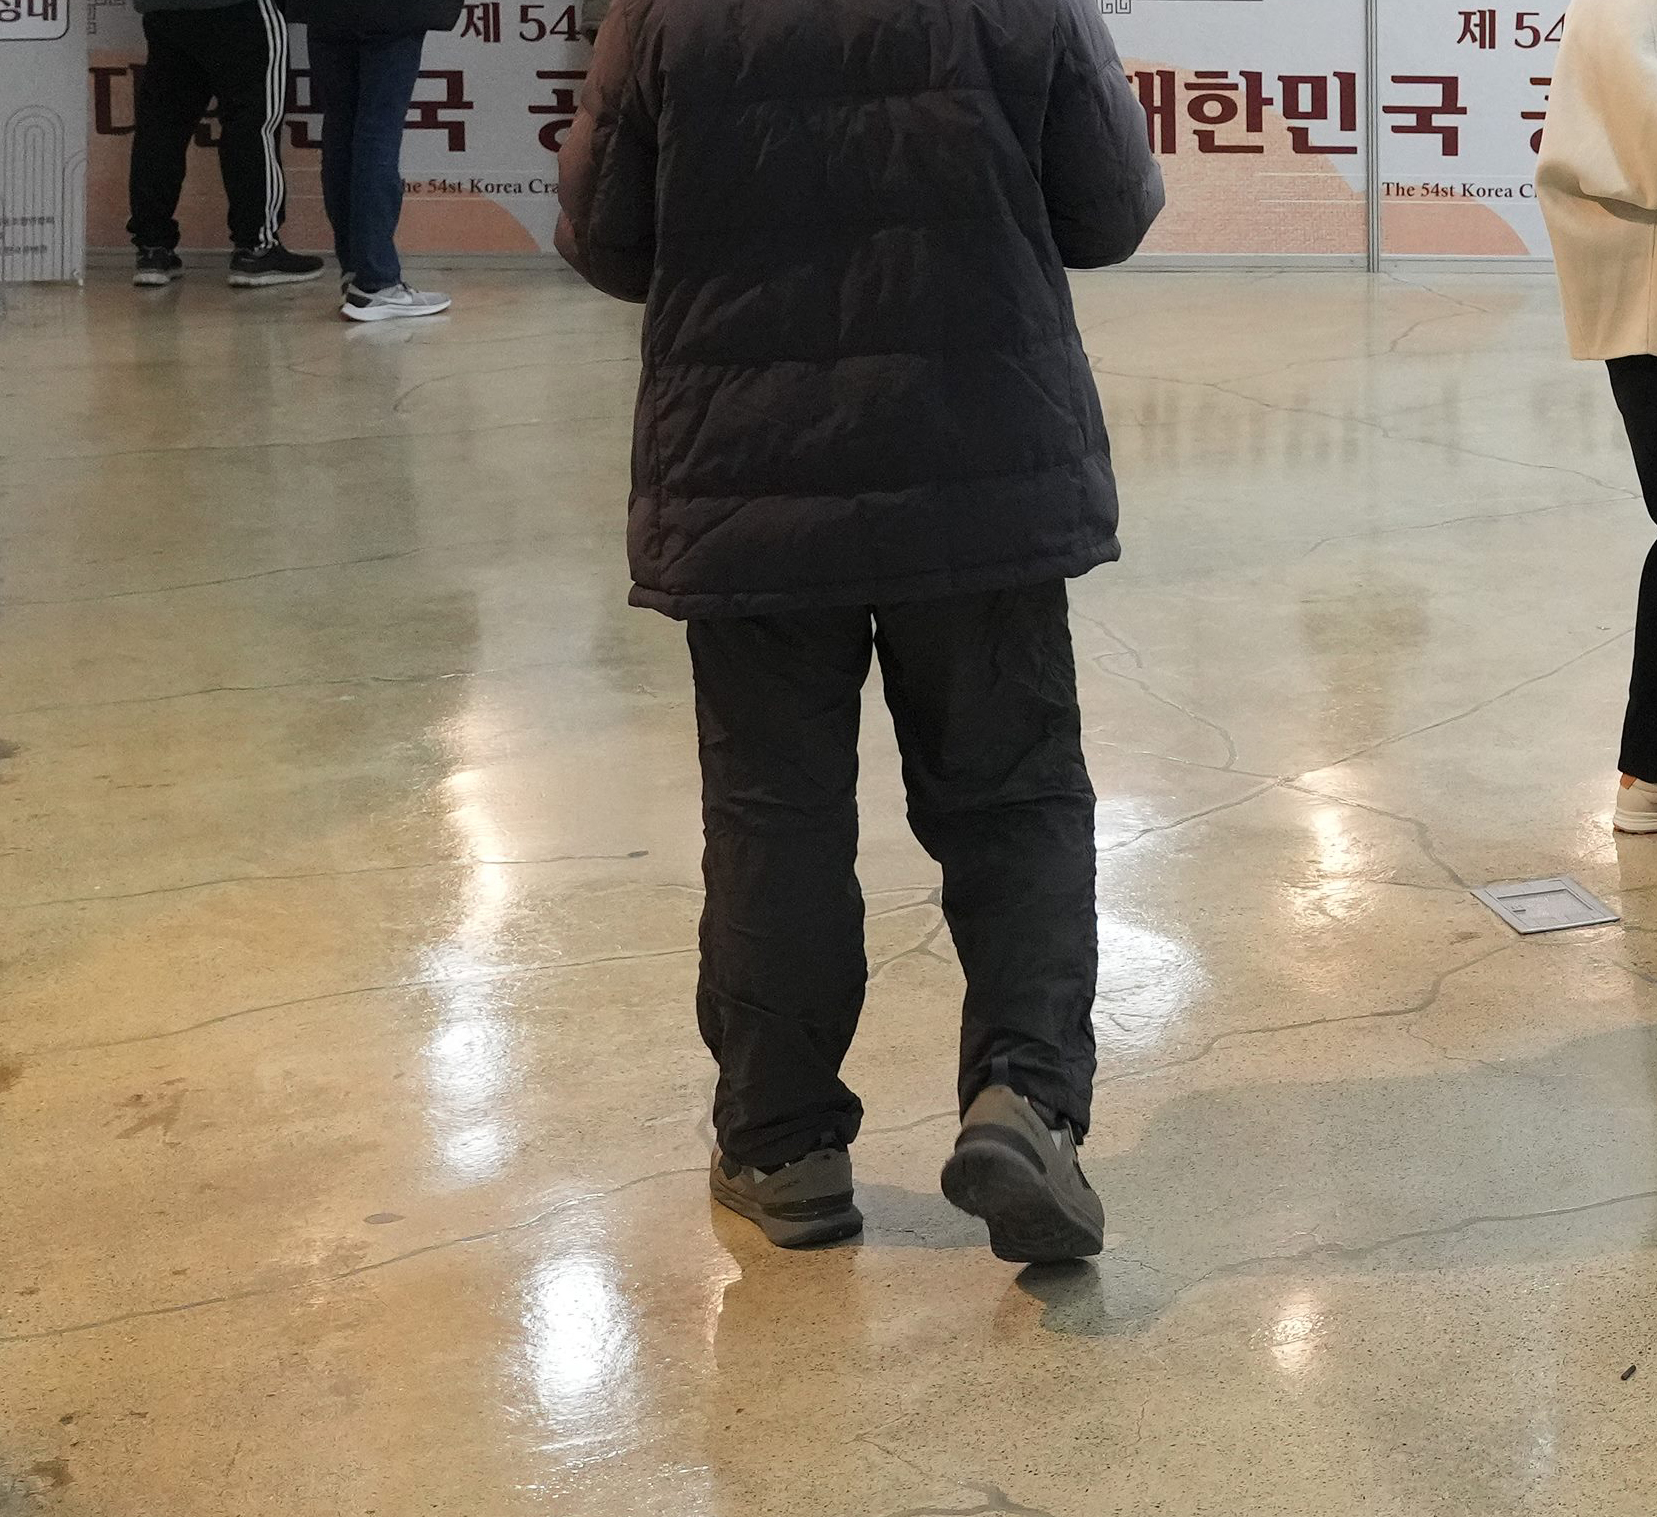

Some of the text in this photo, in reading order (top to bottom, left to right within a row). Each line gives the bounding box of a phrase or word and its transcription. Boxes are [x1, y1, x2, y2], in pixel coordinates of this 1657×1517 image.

[460, 1, 582, 43] 제 54
[1457, 8, 1567, 49] 제 54
[401, 178, 561, 196] he 54st Korea Cra
[1382, 181, 1414, 198] The
[1420, 181, 1456, 198] 54st
[1461, 182, 1513, 198] Korea
